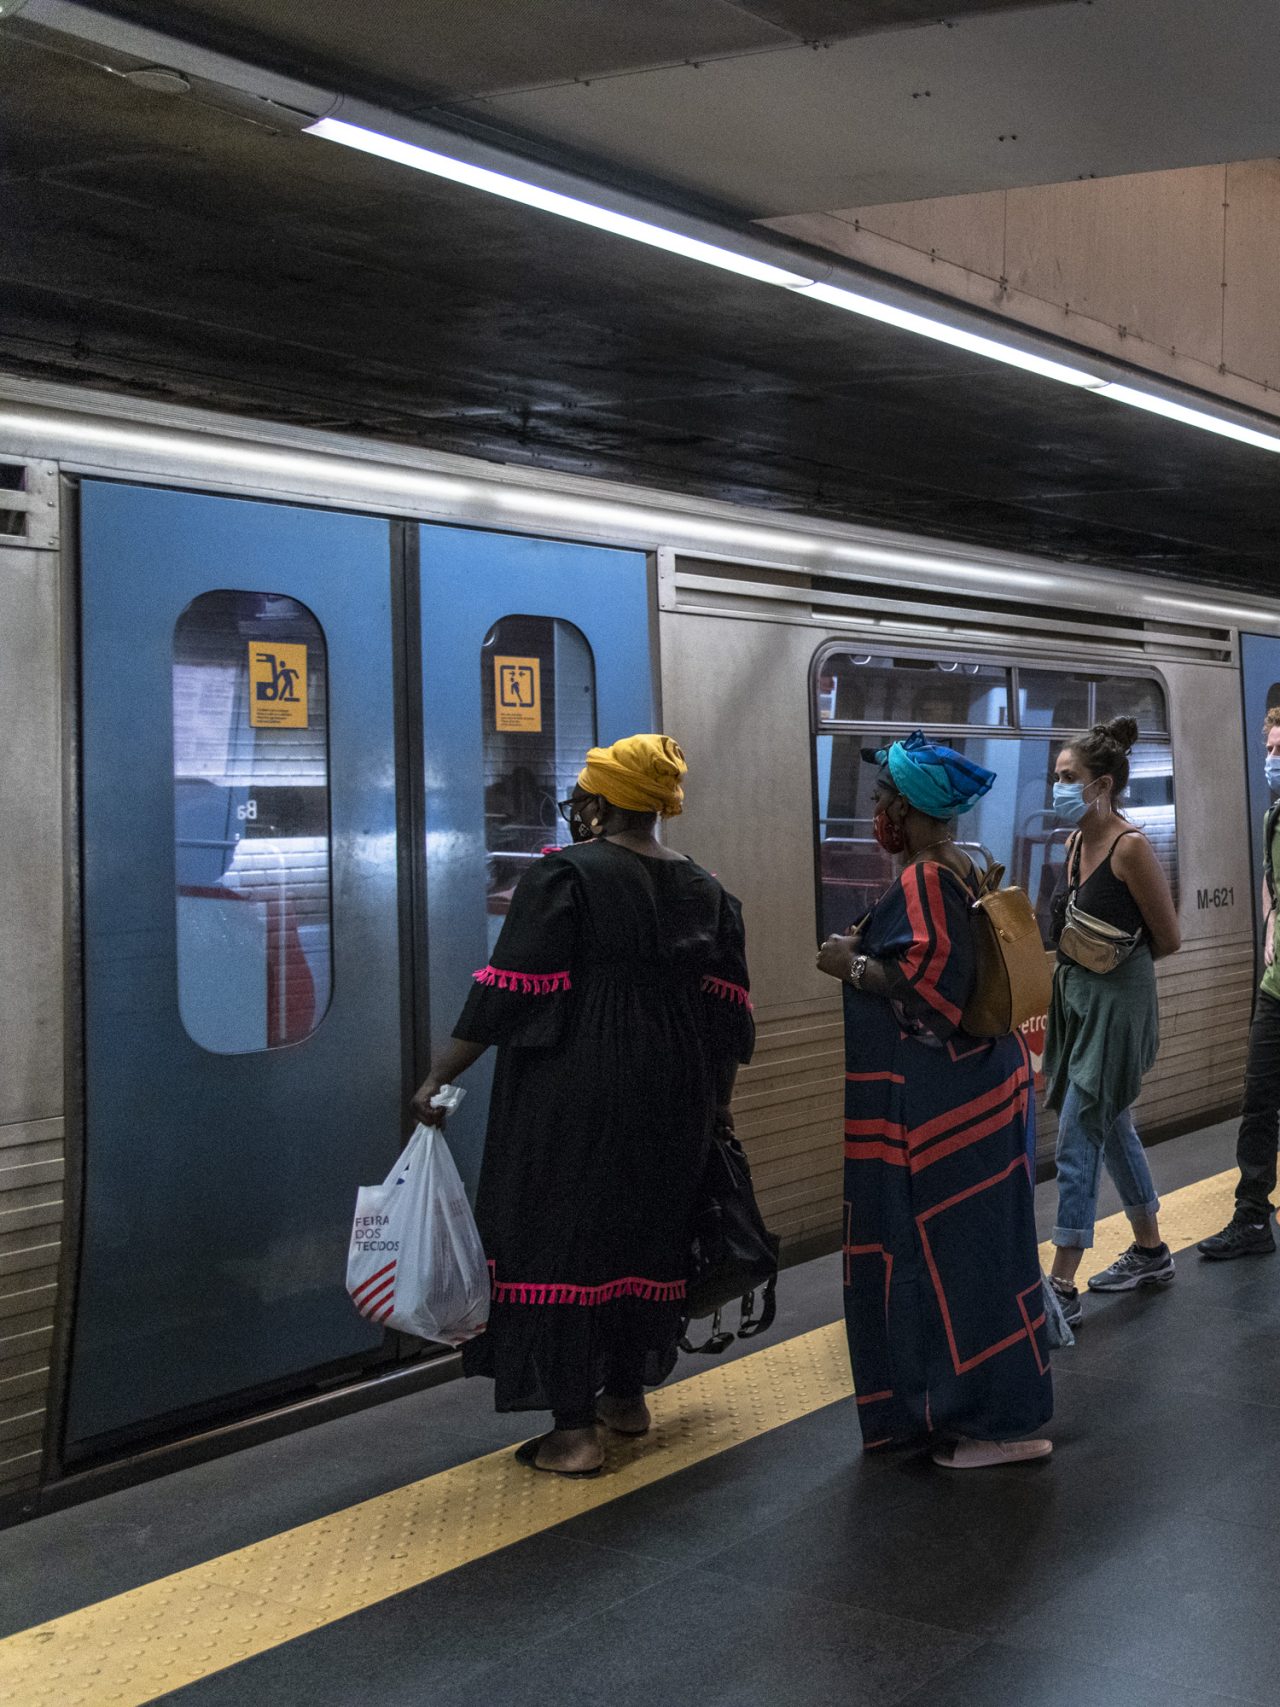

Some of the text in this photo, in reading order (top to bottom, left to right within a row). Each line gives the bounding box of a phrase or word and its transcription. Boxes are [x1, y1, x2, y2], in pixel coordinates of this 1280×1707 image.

[1197, 887, 1234, 909] M-621
[1019, 1014, 1048, 1034] etro
[355, 1215, 390, 1227] FEIRA
[355, 1228, 381, 1240] DOS
[356, 1240, 400, 1251] TECIDOS
